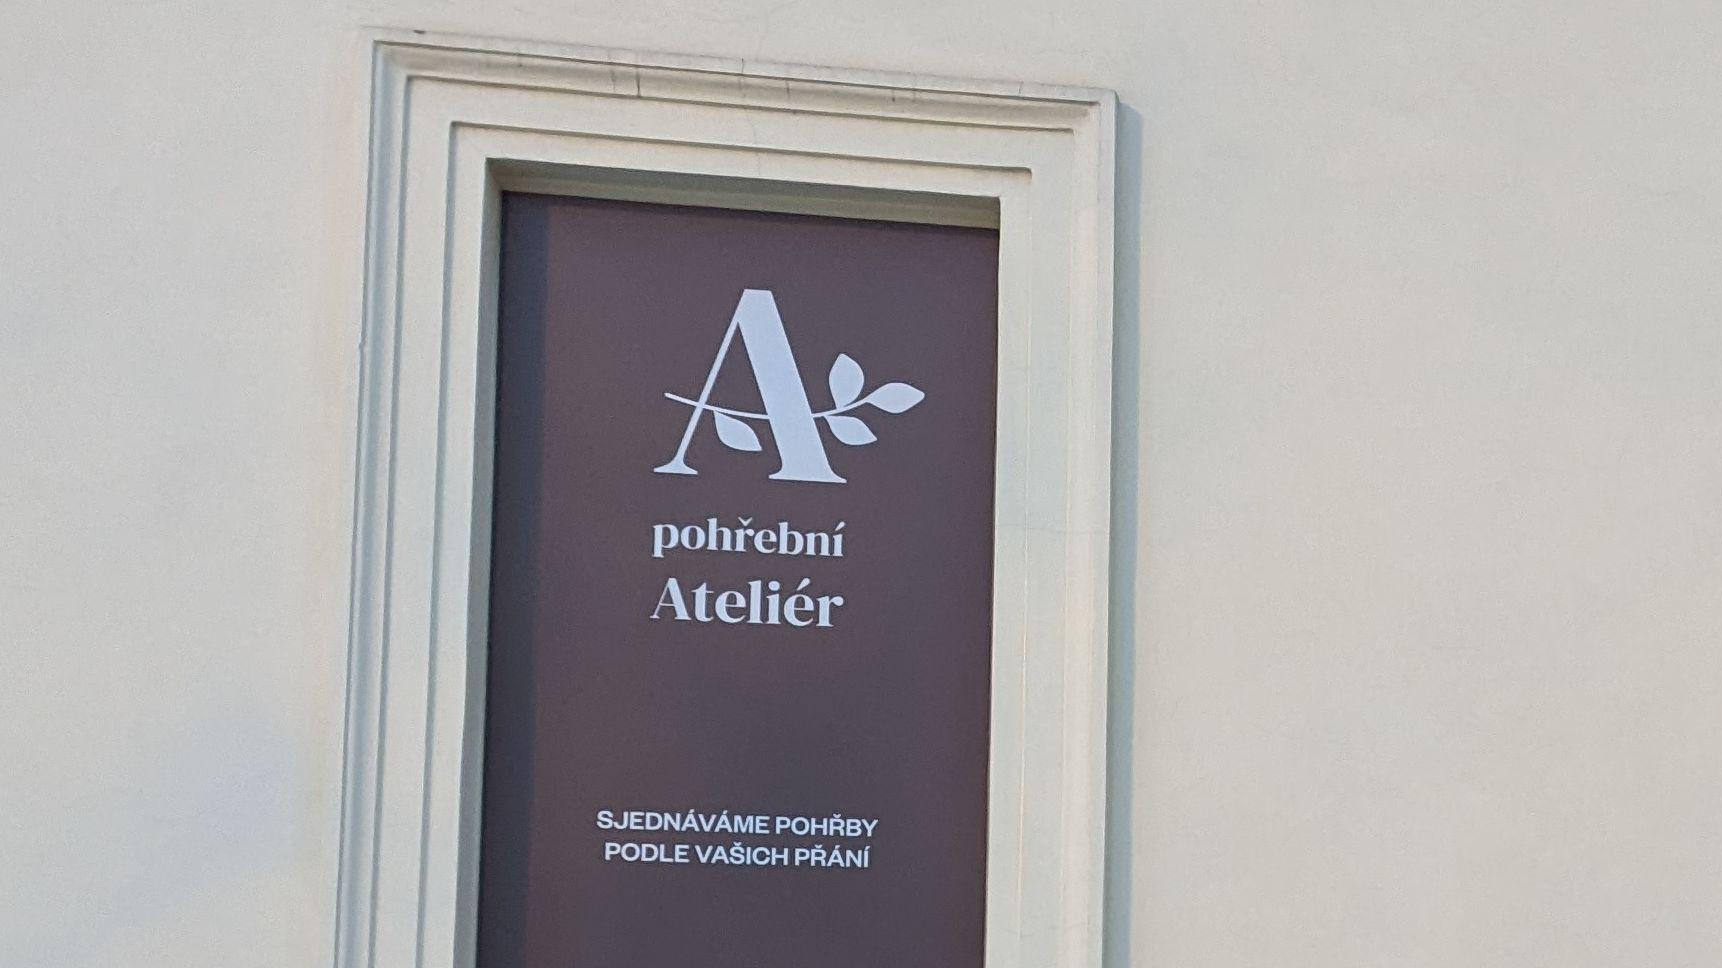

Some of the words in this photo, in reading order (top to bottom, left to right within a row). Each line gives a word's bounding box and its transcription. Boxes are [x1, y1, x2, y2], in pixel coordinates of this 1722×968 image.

[651, 516, 846, 559] pohřební
[649, 577, 844, 627] Ateliér
[596, 808, 770, 834] SJEDNÁVÁME
[775, 813, 879, 837] POHŘBY
[604, 842, 690, 863] PODLE
[694, 840, 789, 866] VAŠICH
[794, 844, 871, 868] PŘÁNÍ
